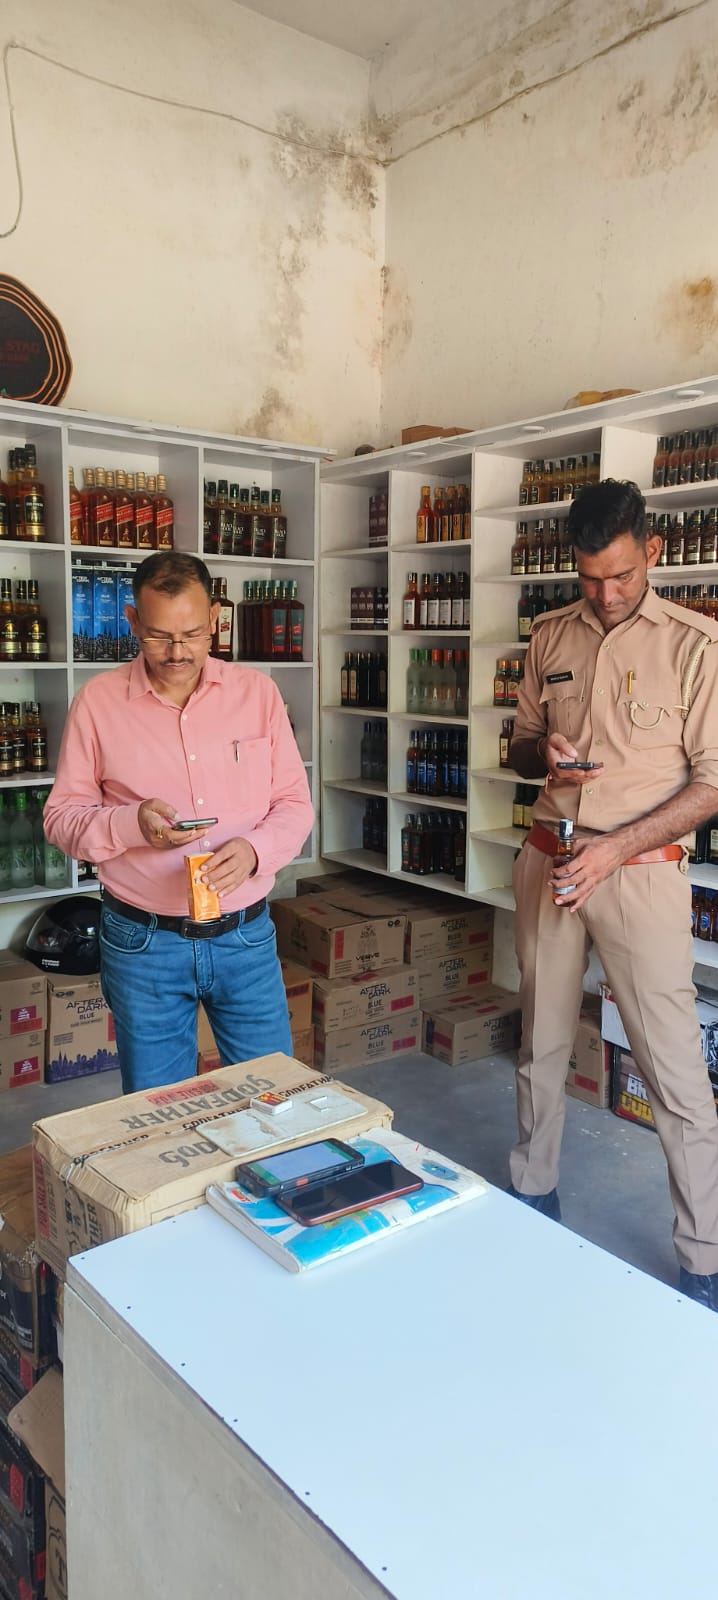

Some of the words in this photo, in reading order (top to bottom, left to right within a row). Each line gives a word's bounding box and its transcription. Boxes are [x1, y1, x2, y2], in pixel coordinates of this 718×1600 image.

[441, 918, 466, 928] AFTER
[439, 958, 464, 969] AFTER
[360, 983, 387, 995] AFTER
[66, 997, 103, 1010] AFTER
[77, 1002, 108, 1014] DARK
[483, 1015, 510, 1028] AFTER
[360, 1024, 390, 1037] AFTER
[369, 1029, 393, 1041] DARK
[120, 1074, 276, 1130] GODFATHER
